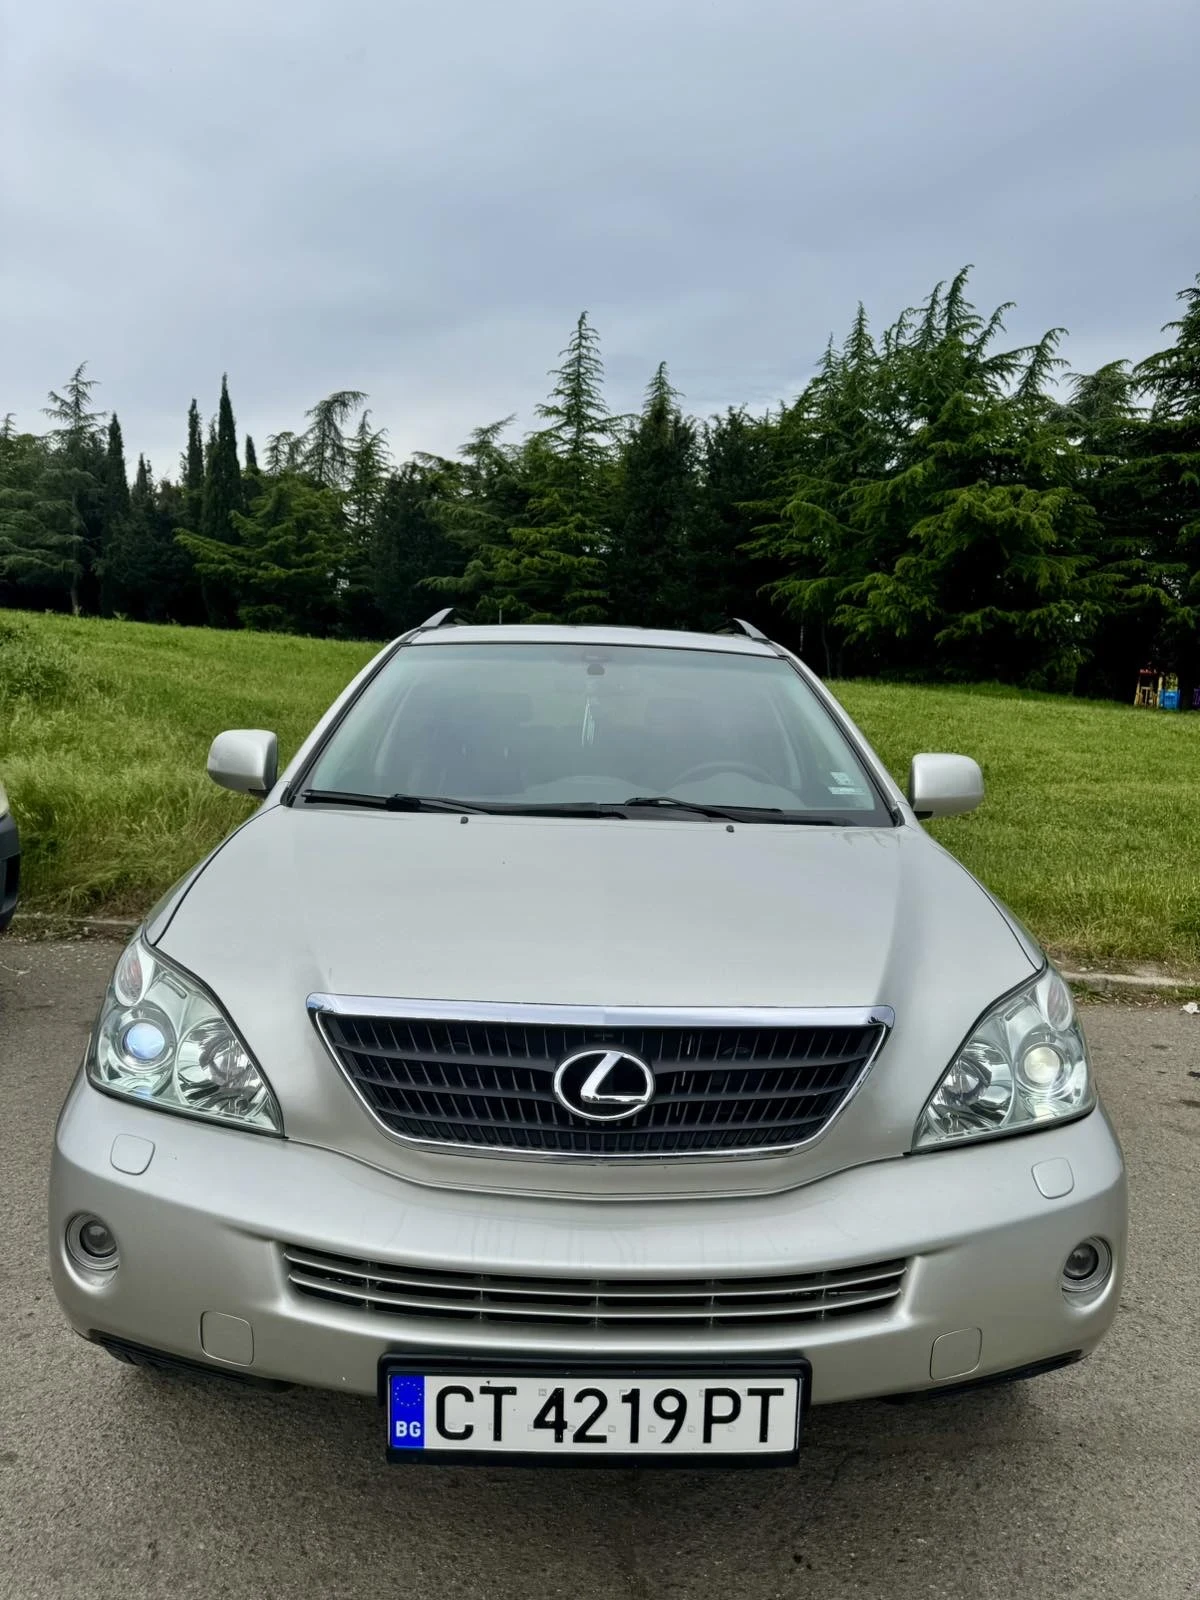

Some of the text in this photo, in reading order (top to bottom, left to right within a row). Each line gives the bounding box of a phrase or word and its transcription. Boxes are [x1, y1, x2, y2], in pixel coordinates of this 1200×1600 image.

[395, 1421, 421, 1438] BG
[435, 1385, 785, 1444] CT 4219 PT
